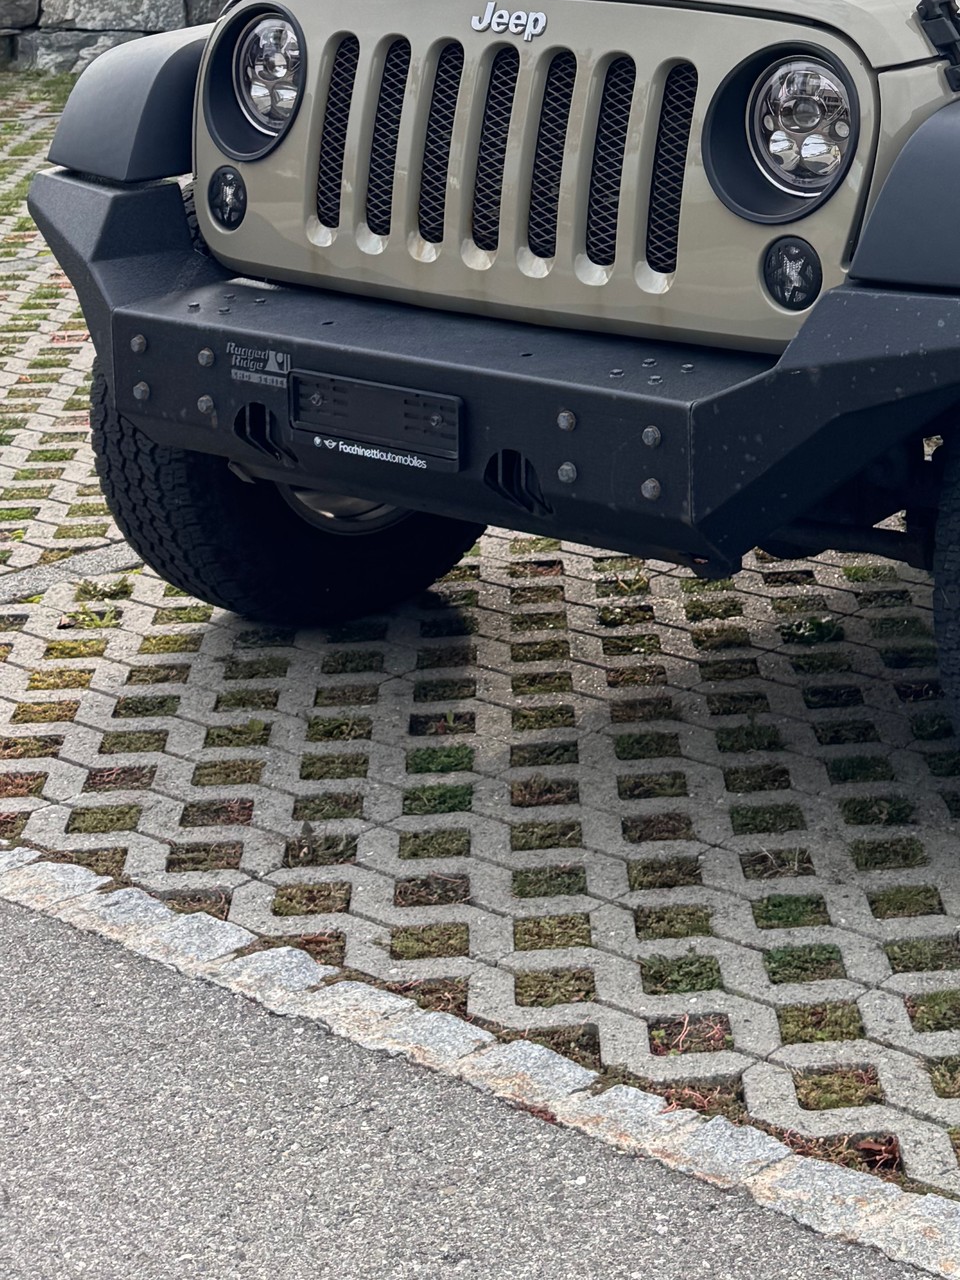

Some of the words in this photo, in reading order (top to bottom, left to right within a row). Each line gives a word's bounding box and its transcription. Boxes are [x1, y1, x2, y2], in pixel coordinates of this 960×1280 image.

[471, 1, 547, 41] Jeep
[226, 342, 269, 360] Rugged
[231, 354, 263, 371] Ridge
